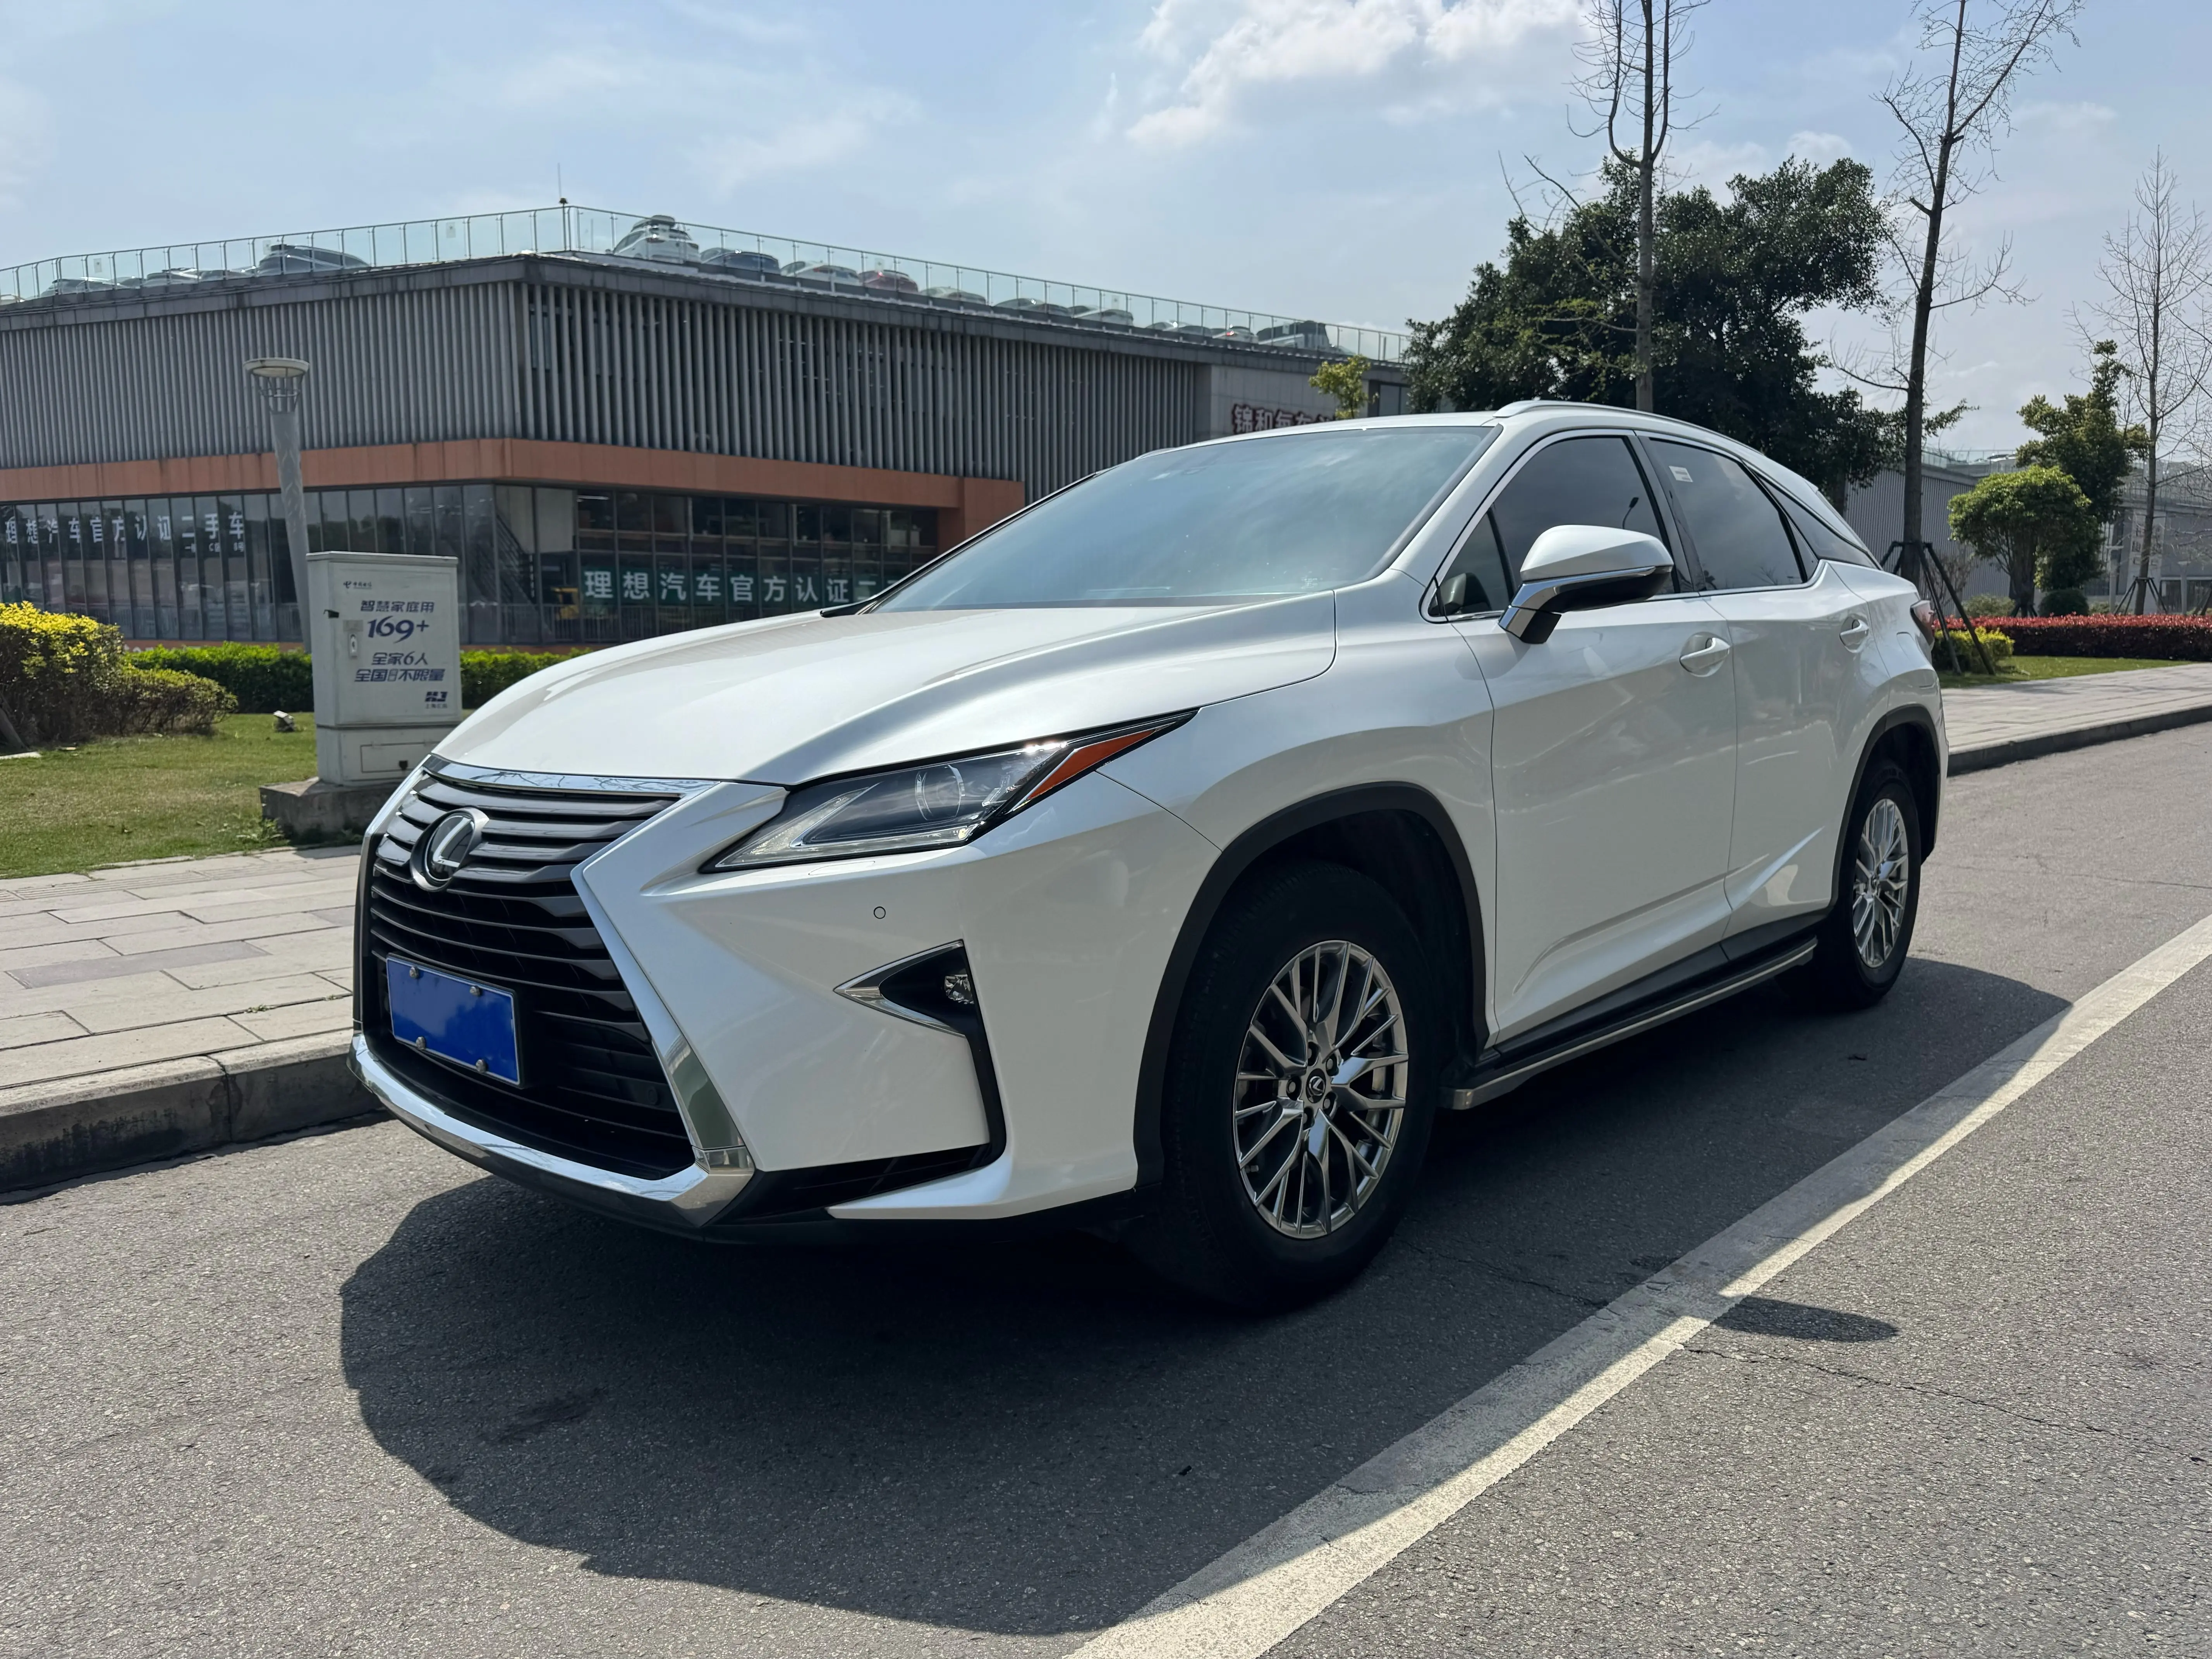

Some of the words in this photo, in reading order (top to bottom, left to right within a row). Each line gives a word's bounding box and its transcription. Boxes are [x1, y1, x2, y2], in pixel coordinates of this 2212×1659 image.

[584, 571, 900, 603] 理想汽车官方认证二
[361, 600, 434, 613] 智慧家庭用
[368, 615, 429, 644] 169+
[371, 651, 428, 665] 全家6人
